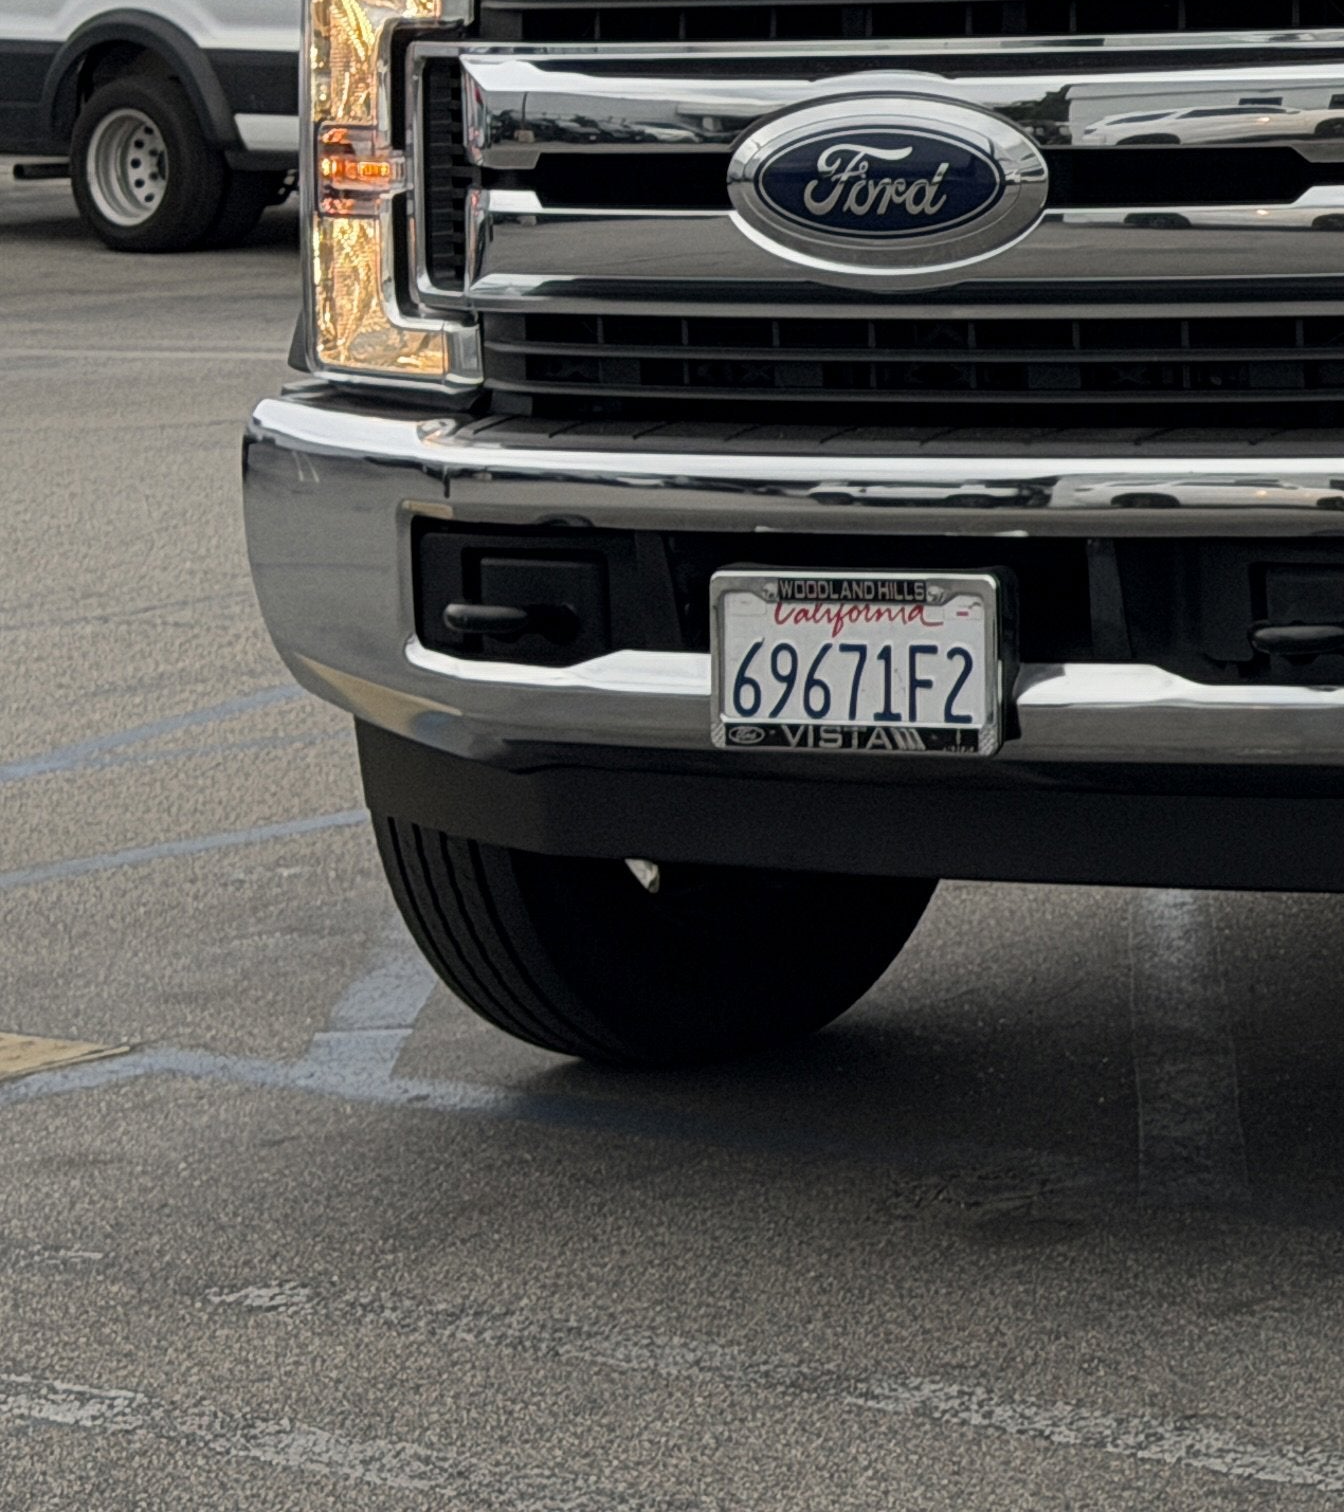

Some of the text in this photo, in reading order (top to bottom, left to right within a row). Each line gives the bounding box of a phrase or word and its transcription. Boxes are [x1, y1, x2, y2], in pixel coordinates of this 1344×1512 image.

[800, 143, 949, 218] Ford
[779, 580, 926, 600] WOODLAND HILLS
[774, 601, 944, 637] California
[732, 638, 974, 723] 69671F2
[780, 725, 893, 750] VISTA
